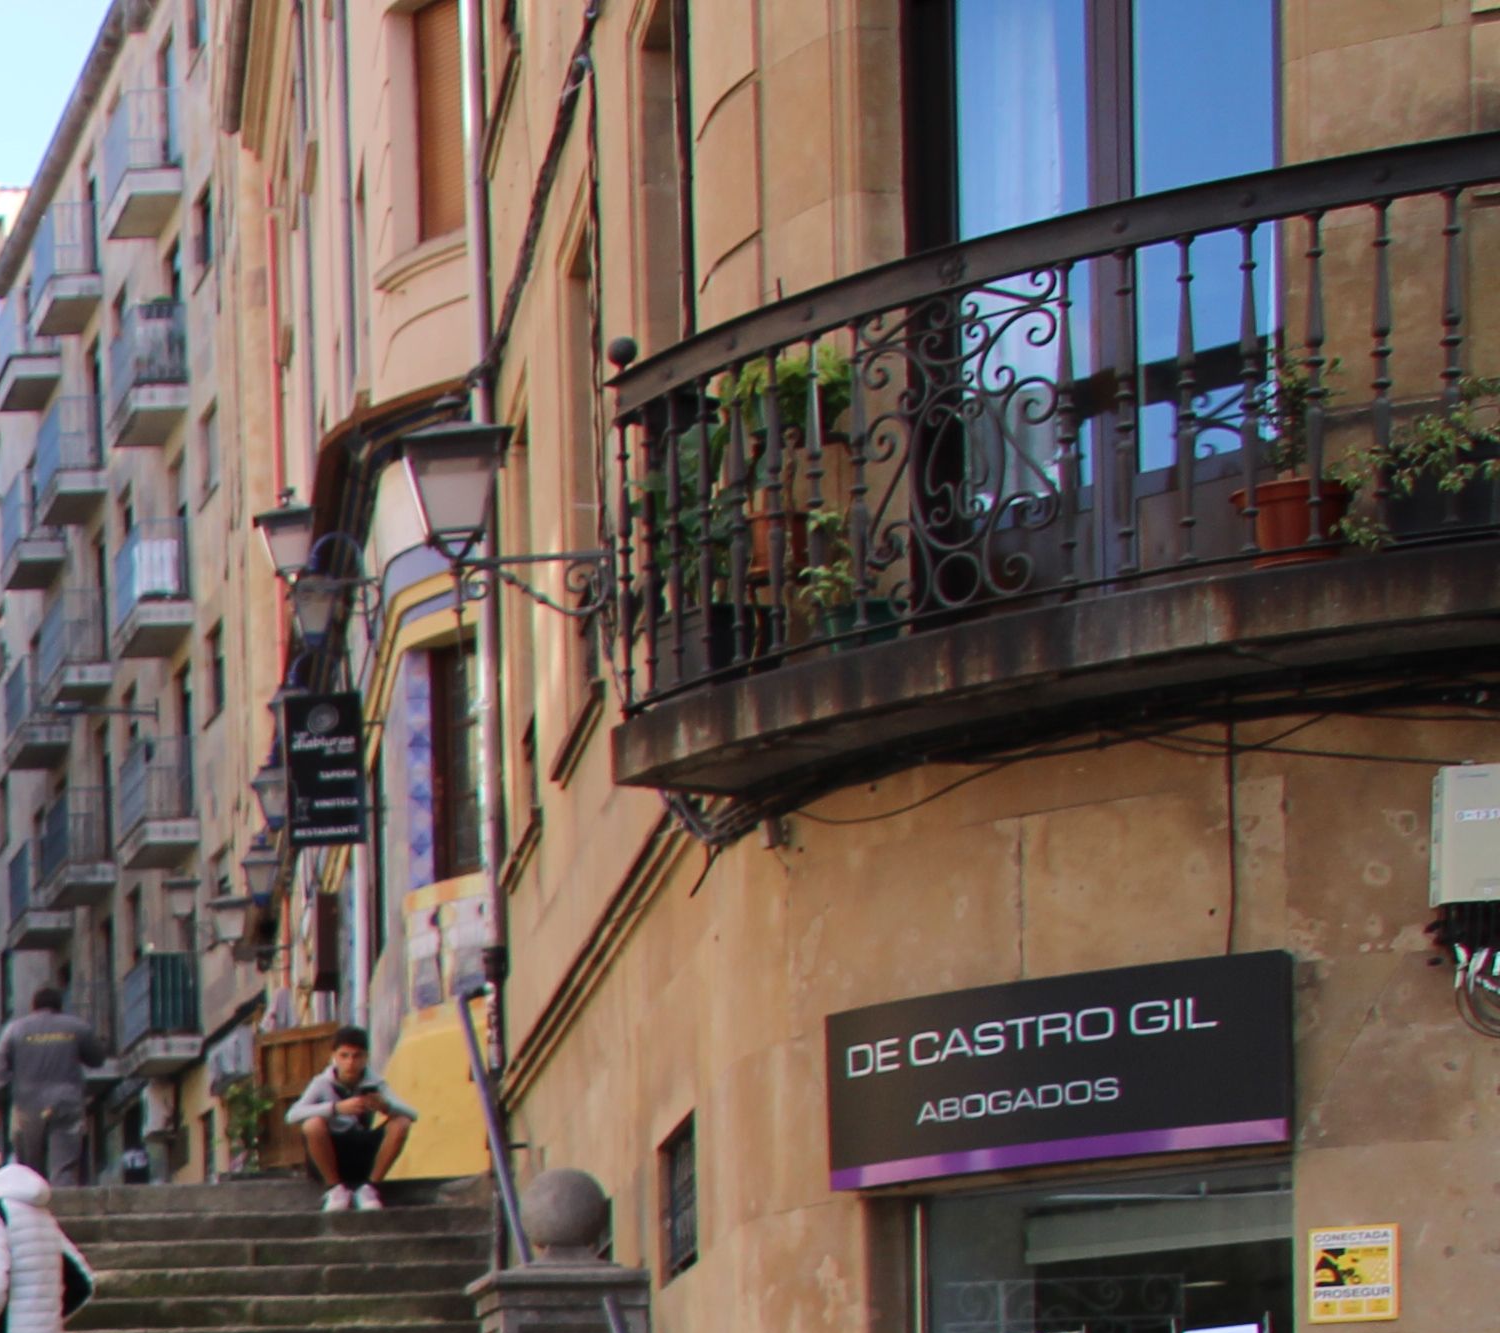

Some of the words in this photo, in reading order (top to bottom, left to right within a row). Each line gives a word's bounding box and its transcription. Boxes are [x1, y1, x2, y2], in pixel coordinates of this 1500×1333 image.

[294, 824, 360, 838] RESTAURANTE
[846, 1038, 901, 1079] DE
[909, 1006, 1116, 1067] CASTRO
[1129, 997, 1219, 1036] GIL
[916, 1077, 1121, 1126] ABOGADOS
[1314, 1230, 1390, 1244] CONECTADA
[1314, 1286, 1391, 1300] PROSEGUR
